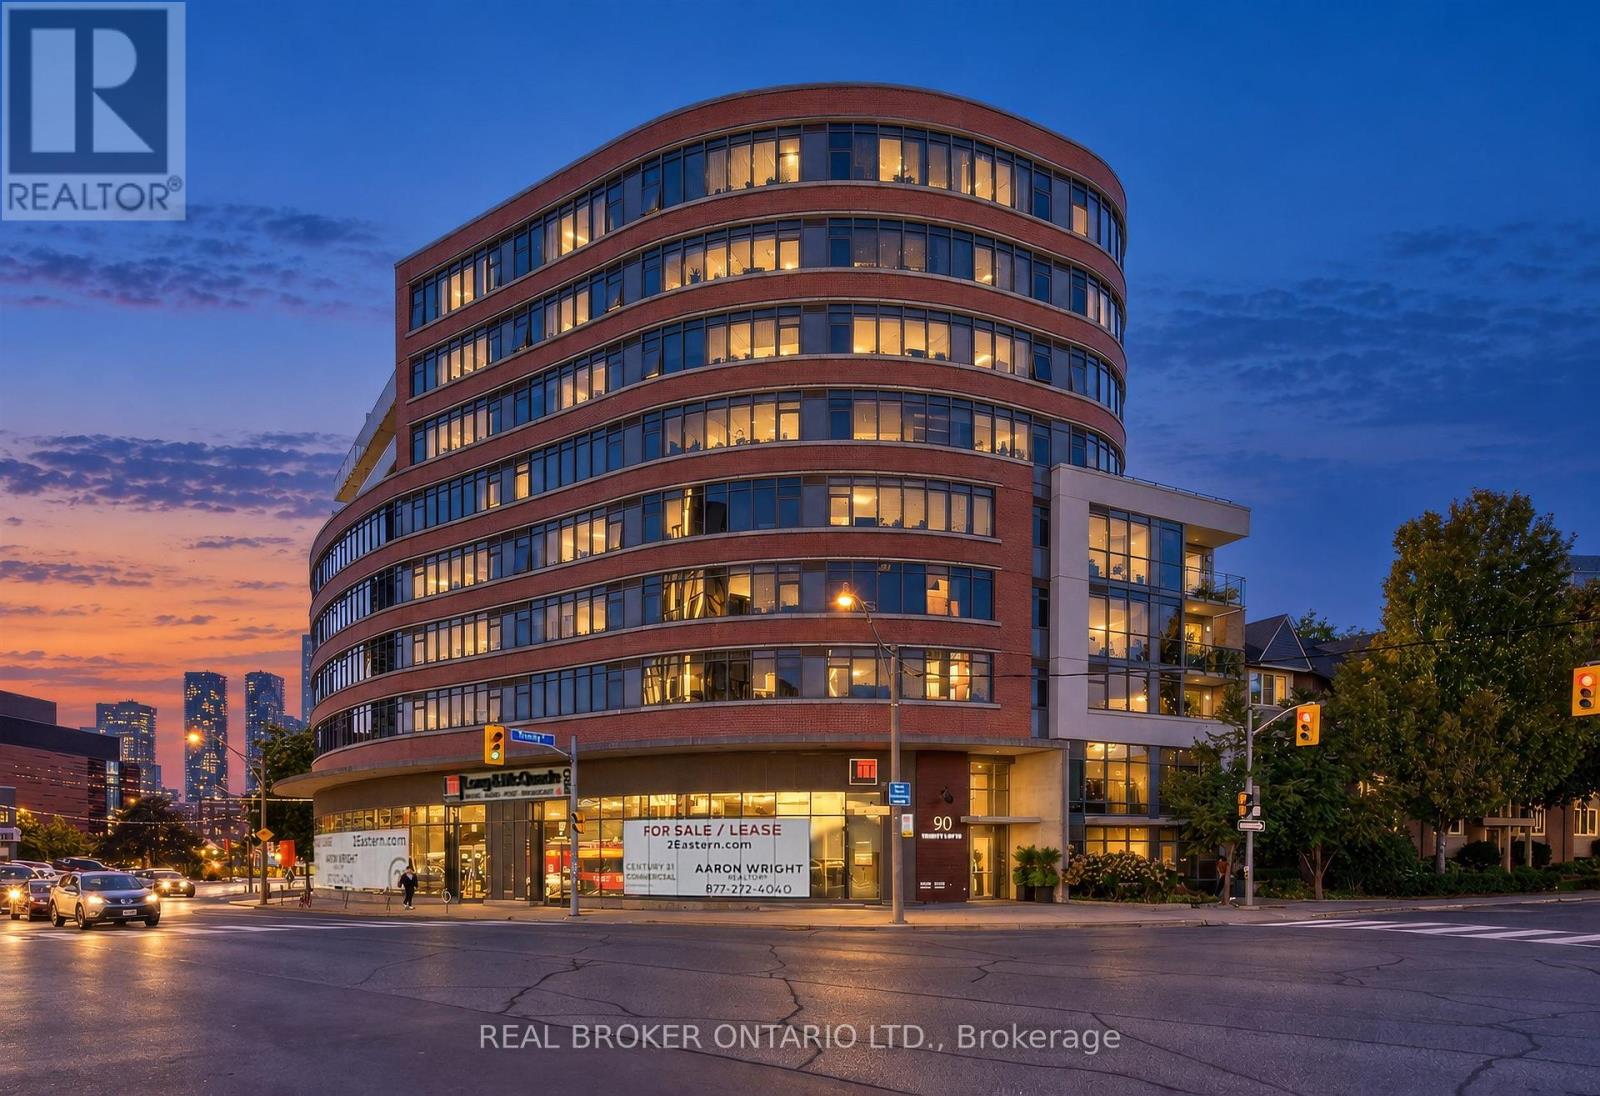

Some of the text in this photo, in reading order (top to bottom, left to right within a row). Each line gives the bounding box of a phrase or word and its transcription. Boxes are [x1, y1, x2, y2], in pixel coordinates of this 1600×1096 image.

[933, 816, 952, 831] 90
[643, 825, 670, 837] FOR
[675, 824, 712, 837] SALE
[730, 824, 782, 836] LEASE
[667, 840, 751, 850] 2Eastern.com
[695, 864, 803, 874] AARON WRIGHT
[705, 884, 792, 894] 877-272-4040
